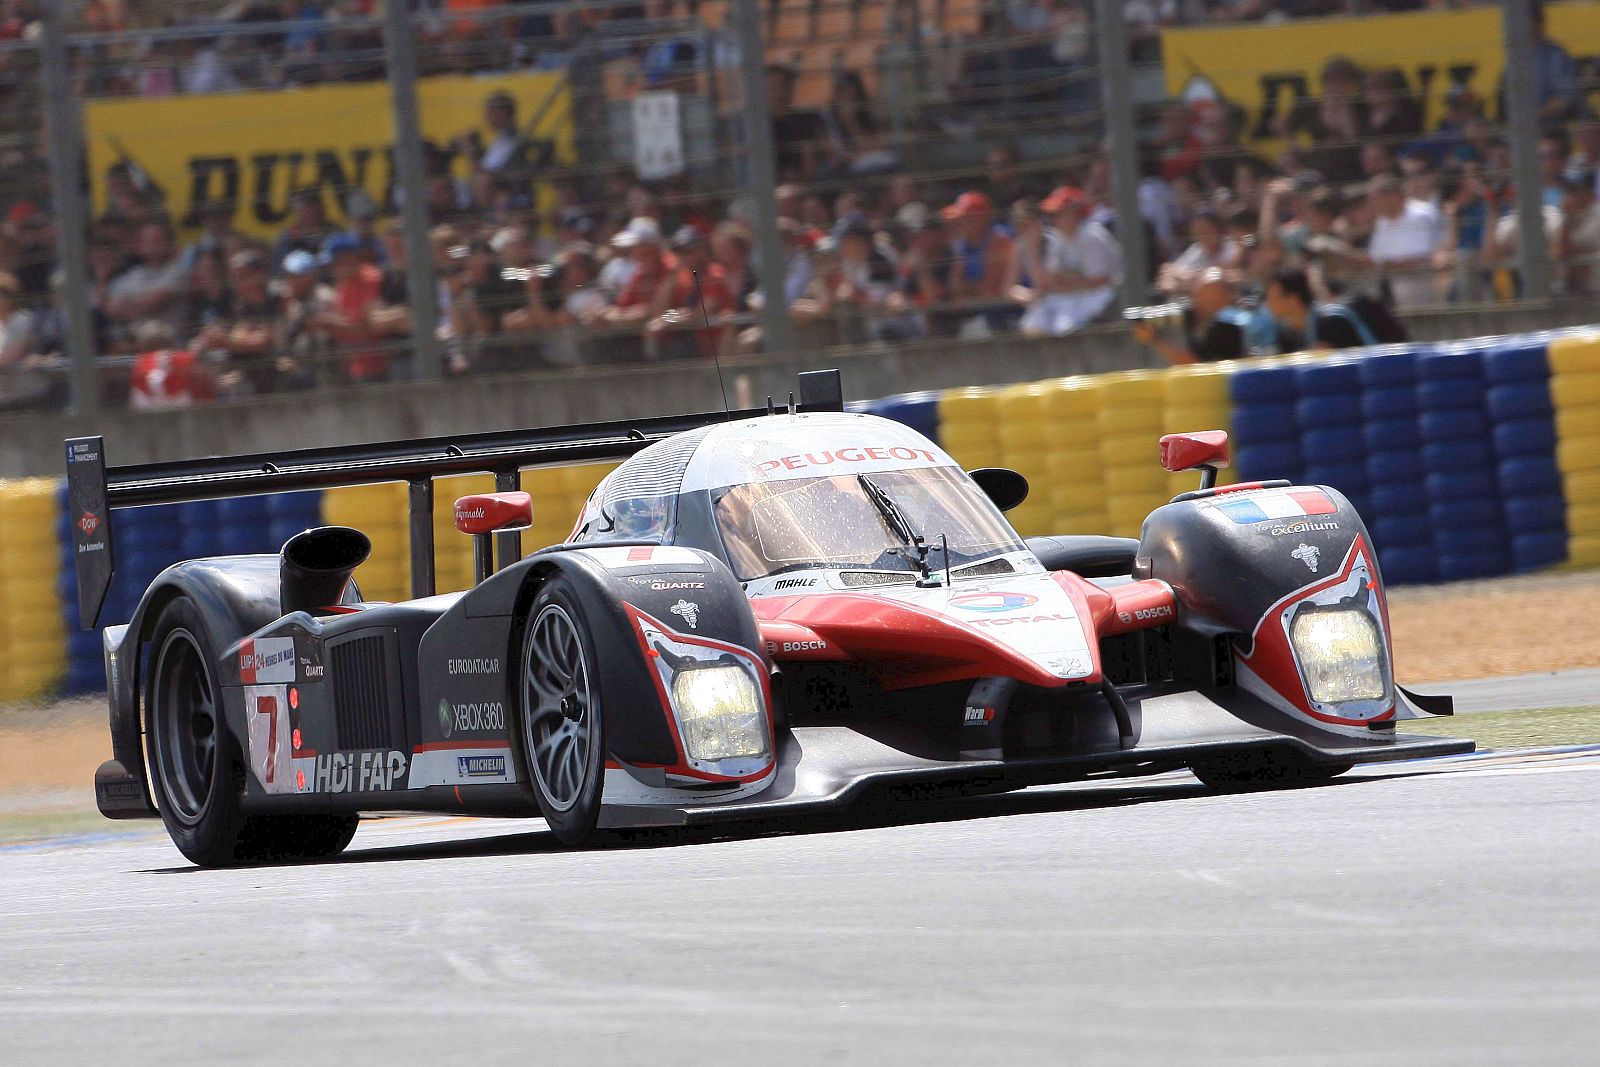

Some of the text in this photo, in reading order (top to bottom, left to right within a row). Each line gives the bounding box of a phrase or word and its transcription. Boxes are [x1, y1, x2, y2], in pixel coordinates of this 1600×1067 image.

[755, 446, 937, 476] PEUGEOT
[82, 518, 96, 530] DOW
[1271, 521, 1340, 536] excellium
[651, 582, 705, 590] QUARTZ
[774, 578, 818, 590] MAHLE
[966, 613, 1077, 628] TOTAL
[1134, 605, 1173, 621] BOSCH
[783, 640, 827, 653] BOSCH
[305, 665, 324, 677] QUARTZ
[448, 658, 500, 675] EURODATACAR
[257, 696, 278, 784] 7
[315, 751, 407, 793] HDi FAP
[469, 759, 504, 771] MICHELIN
